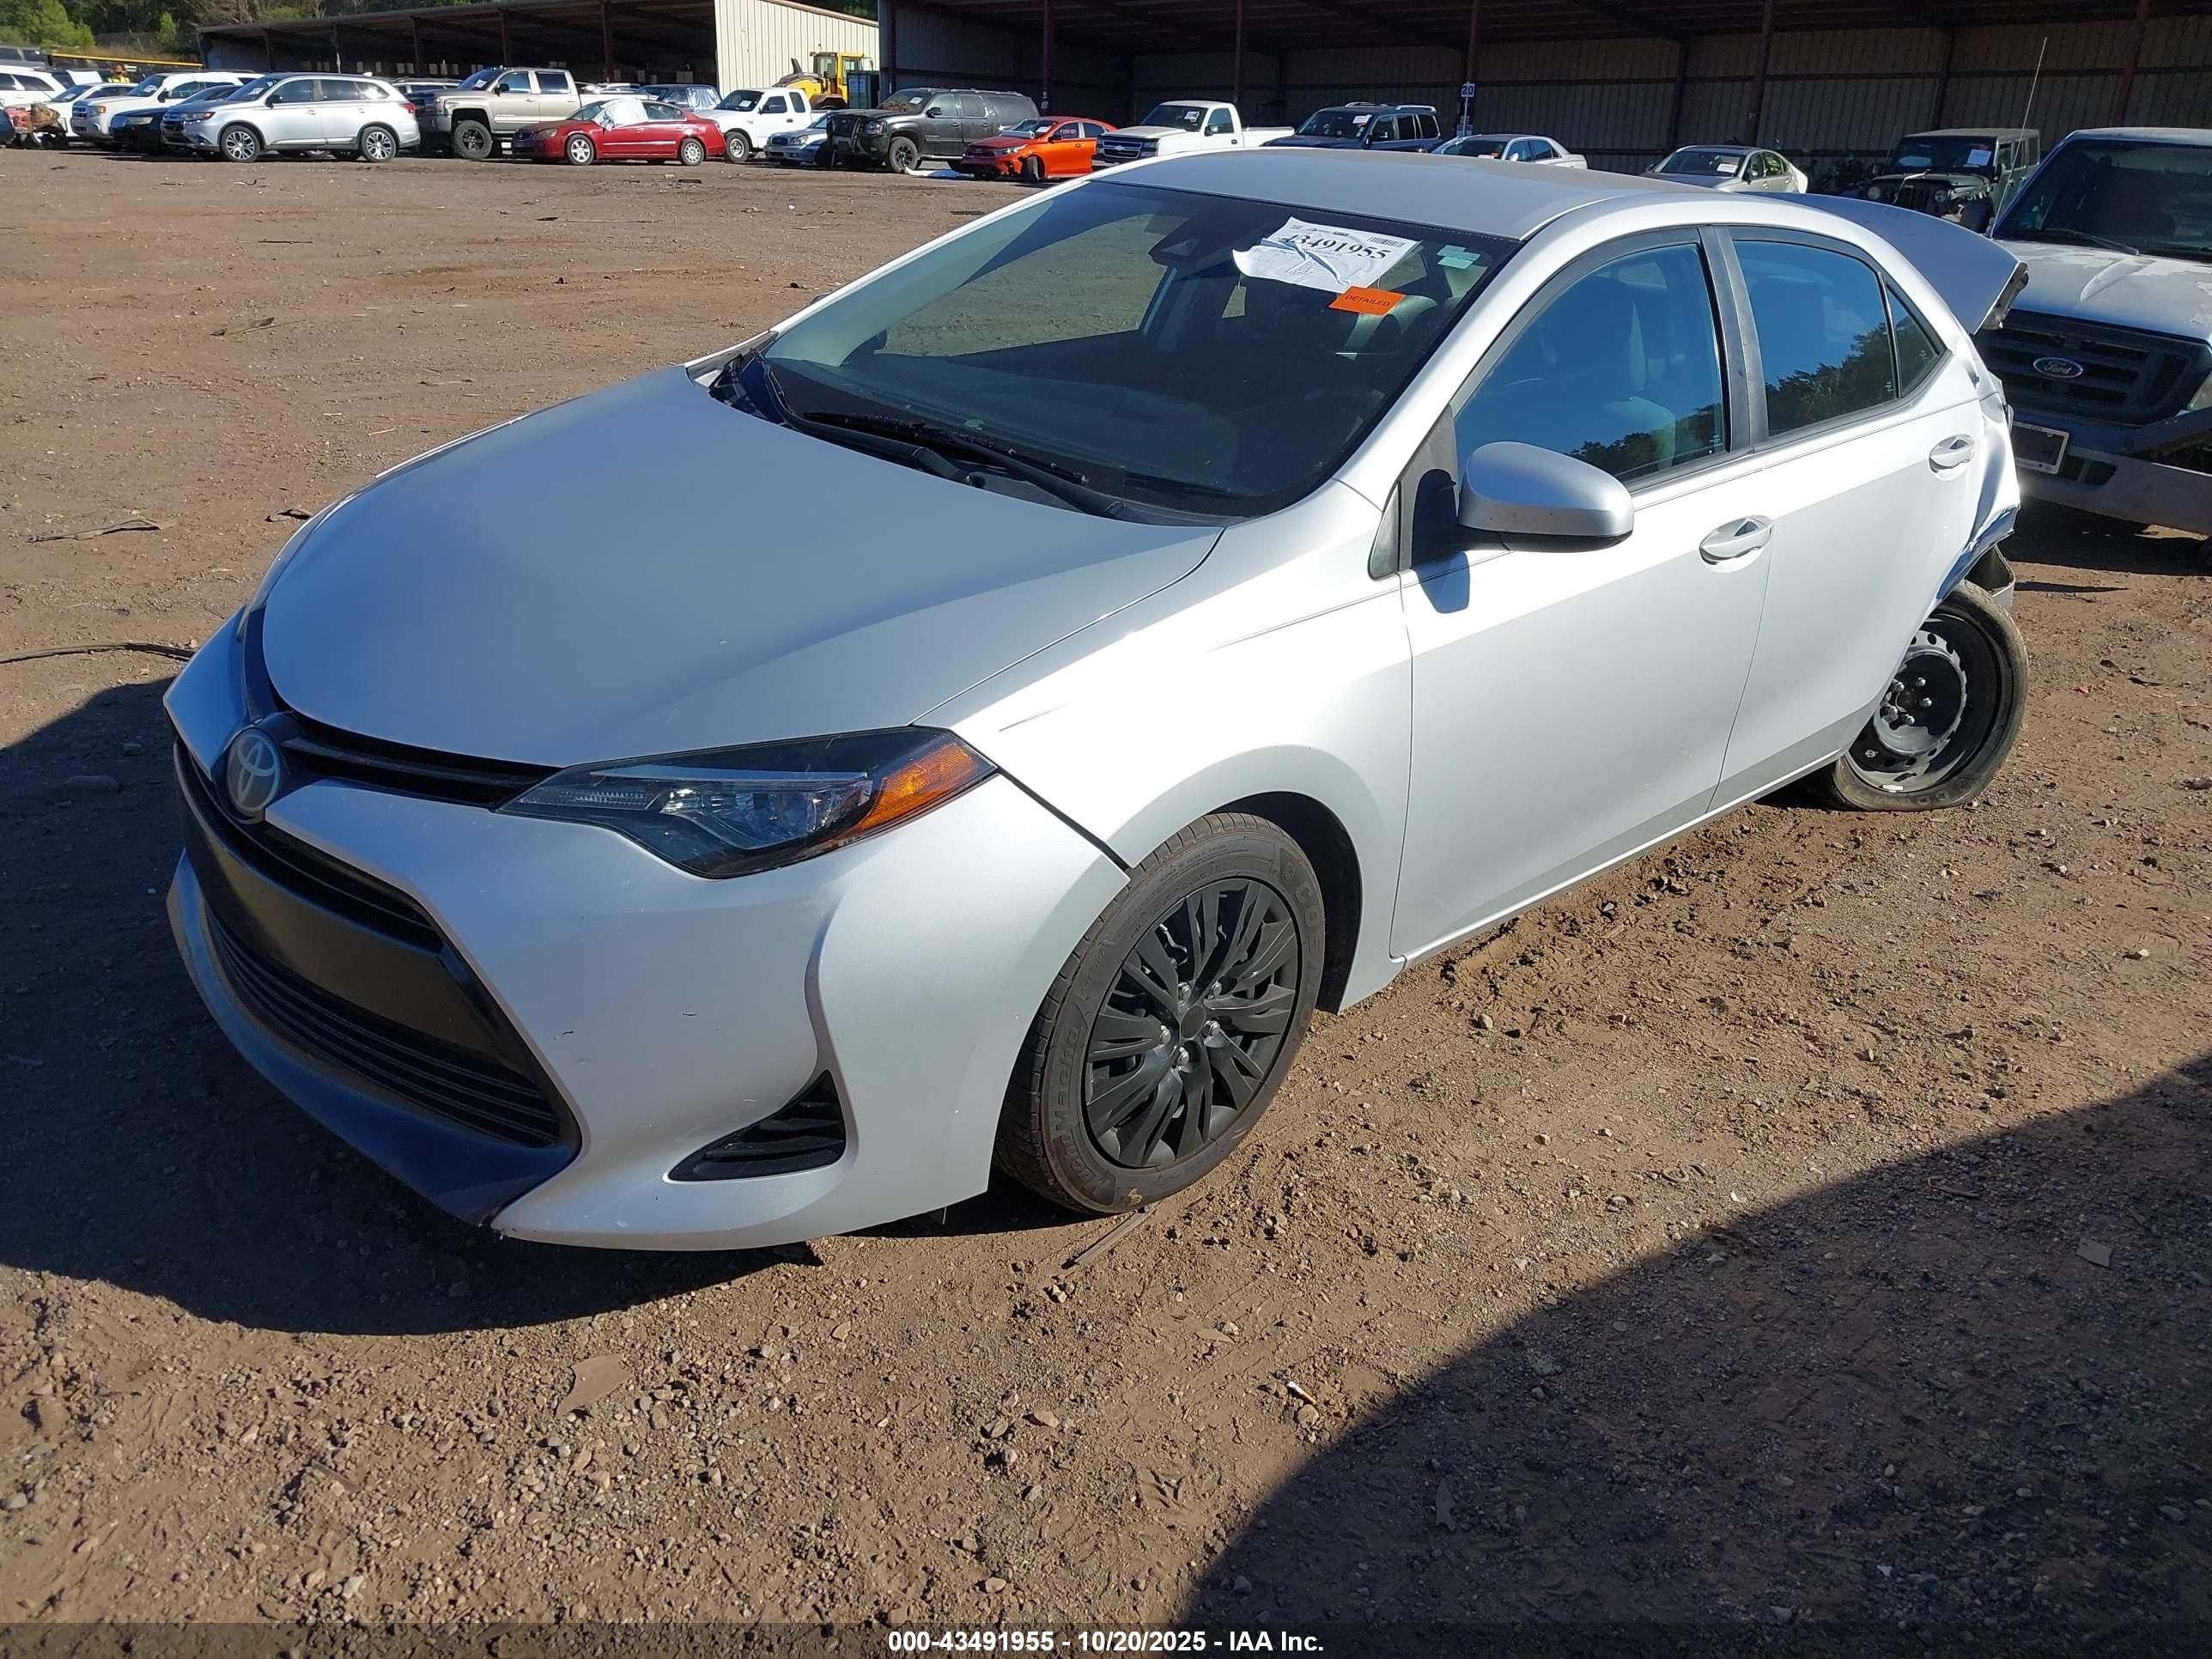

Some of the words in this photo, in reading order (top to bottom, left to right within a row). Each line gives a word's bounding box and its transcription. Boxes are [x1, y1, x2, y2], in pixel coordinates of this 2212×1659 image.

[1462, 85, 1474, 95] 20
[1345, 295, 1391, 307] DETAILED
[2043, 360, 2074, 374] Ford
